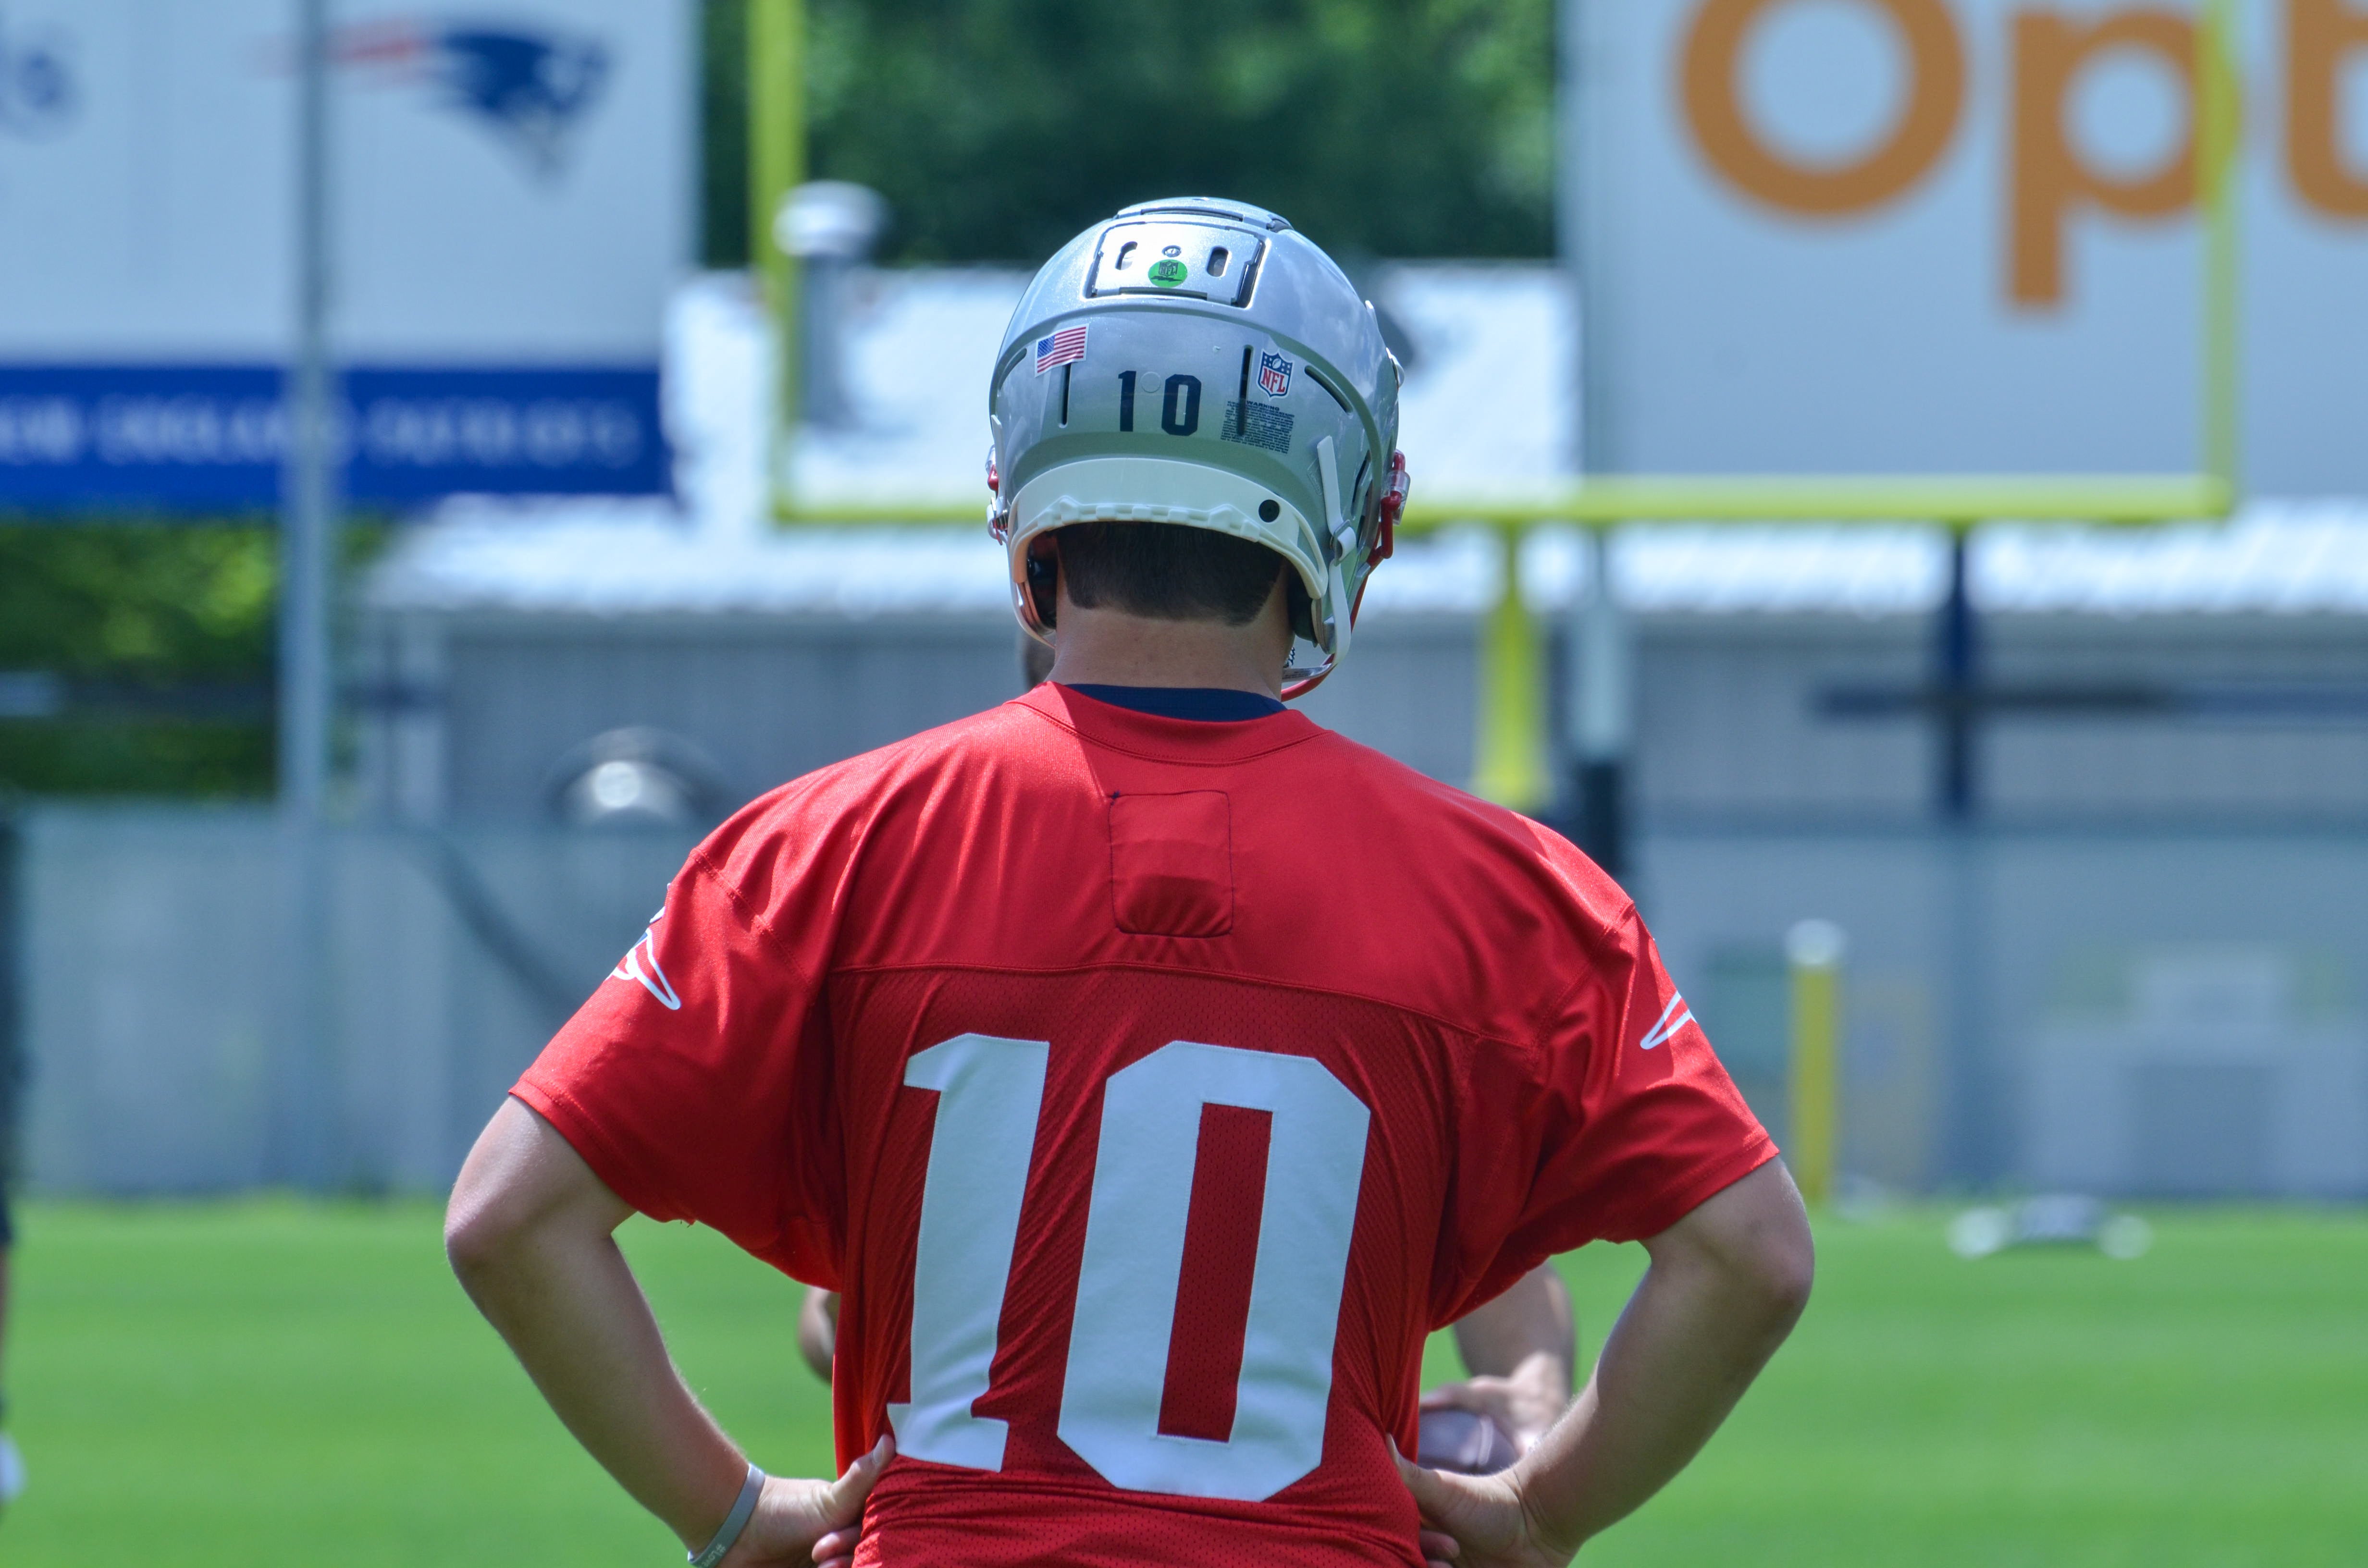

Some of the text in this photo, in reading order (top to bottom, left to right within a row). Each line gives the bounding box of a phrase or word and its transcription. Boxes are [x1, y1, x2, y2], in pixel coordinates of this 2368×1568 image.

[1118, 370, 1202, 436] 10
[1261, 368, 1286, 393] NFL
[1246, 400, 1280, 411] WARNING
[887, 1032, 1371, 1502] 10
